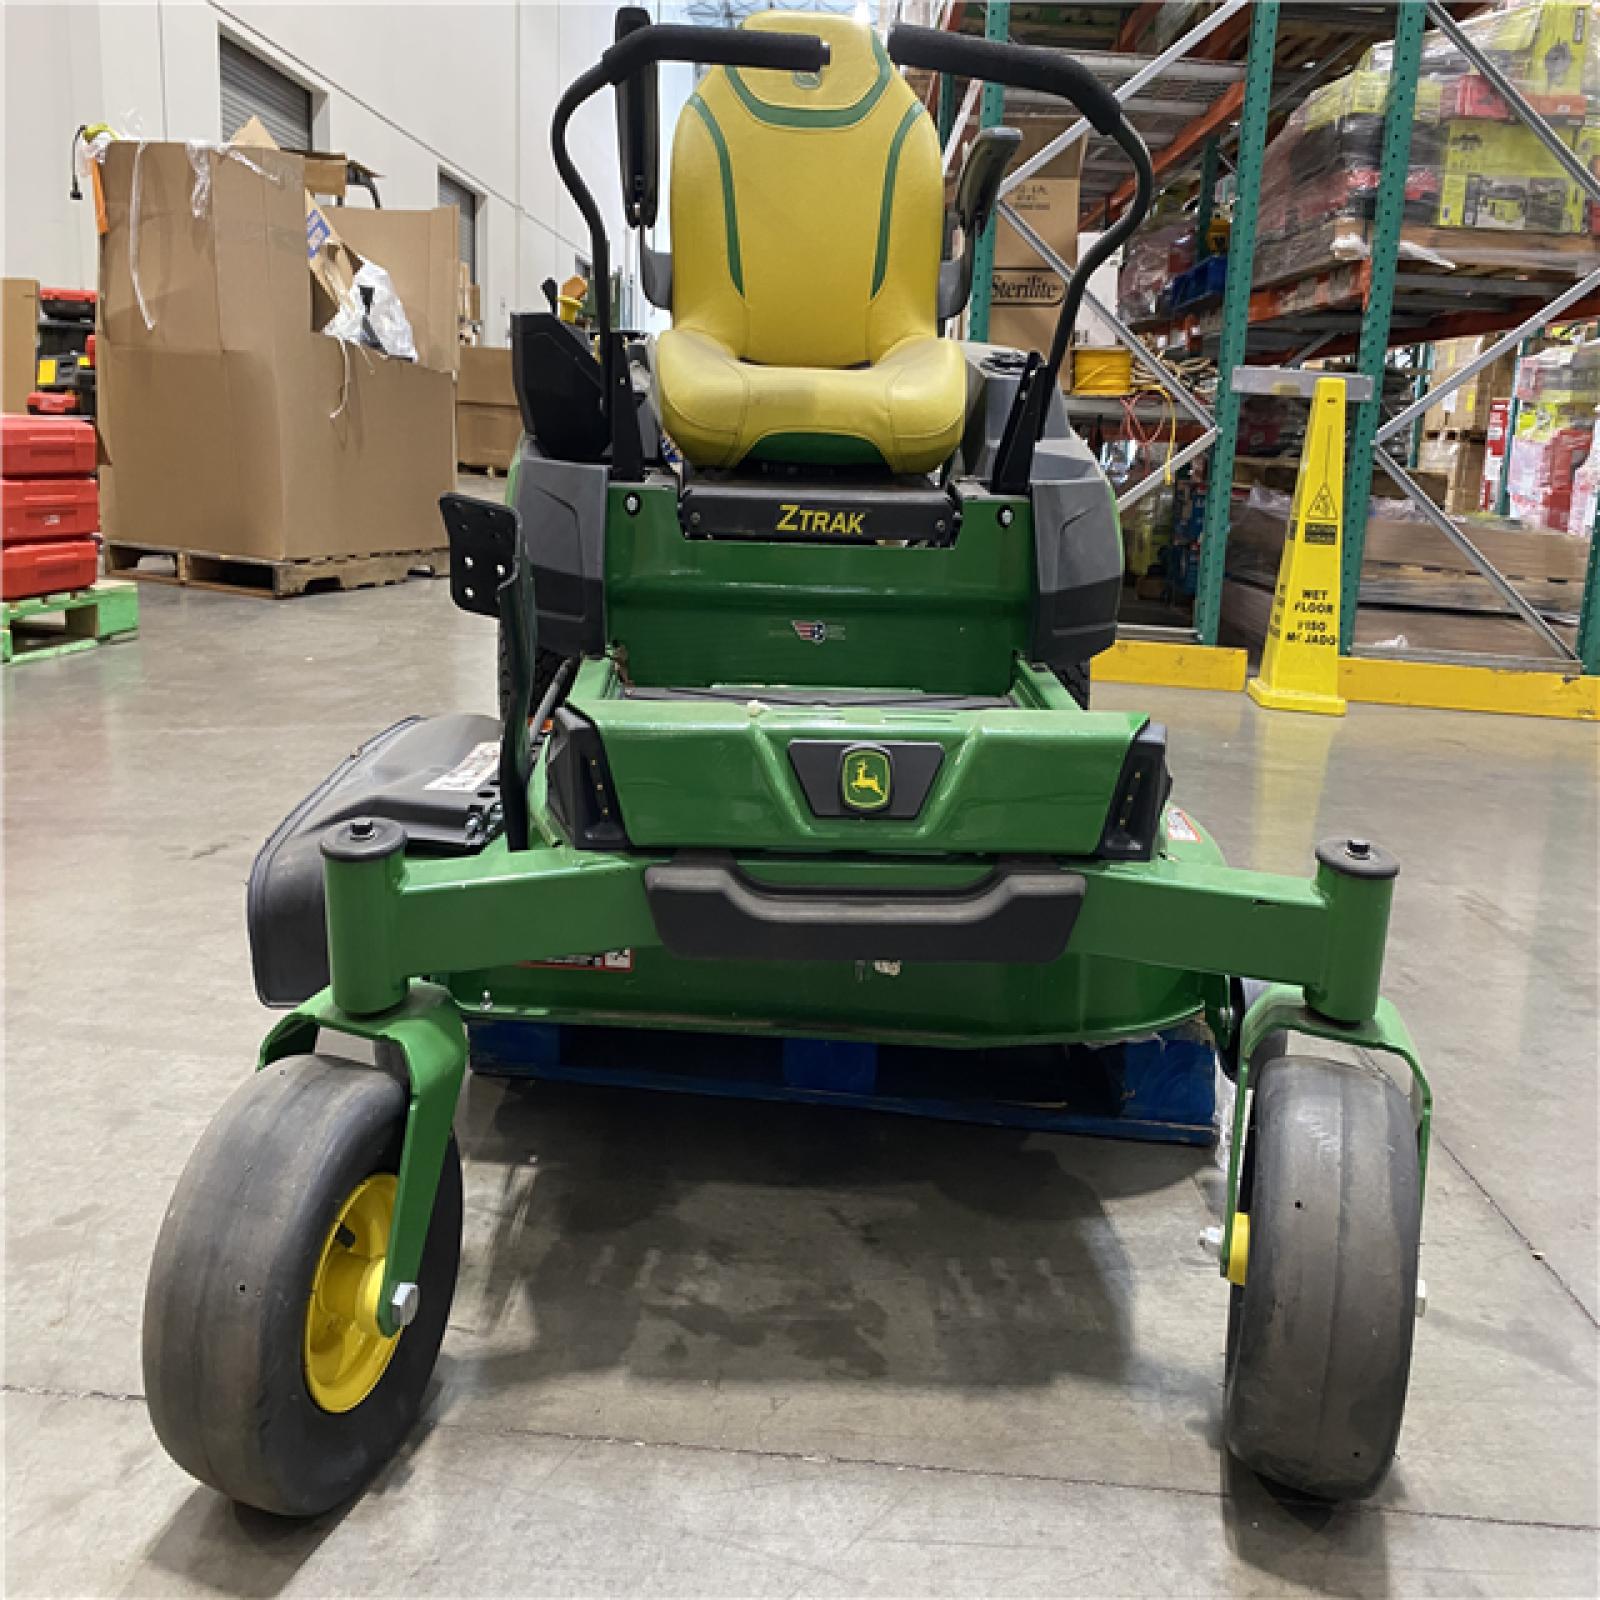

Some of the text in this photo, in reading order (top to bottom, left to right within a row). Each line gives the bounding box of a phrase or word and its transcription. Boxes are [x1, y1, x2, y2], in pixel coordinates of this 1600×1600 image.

[776, 504, 865, 535] ZTRAK
[1302, 589, 1328, 600] WET
[1294, 602, 1333, 615] FLOOR
